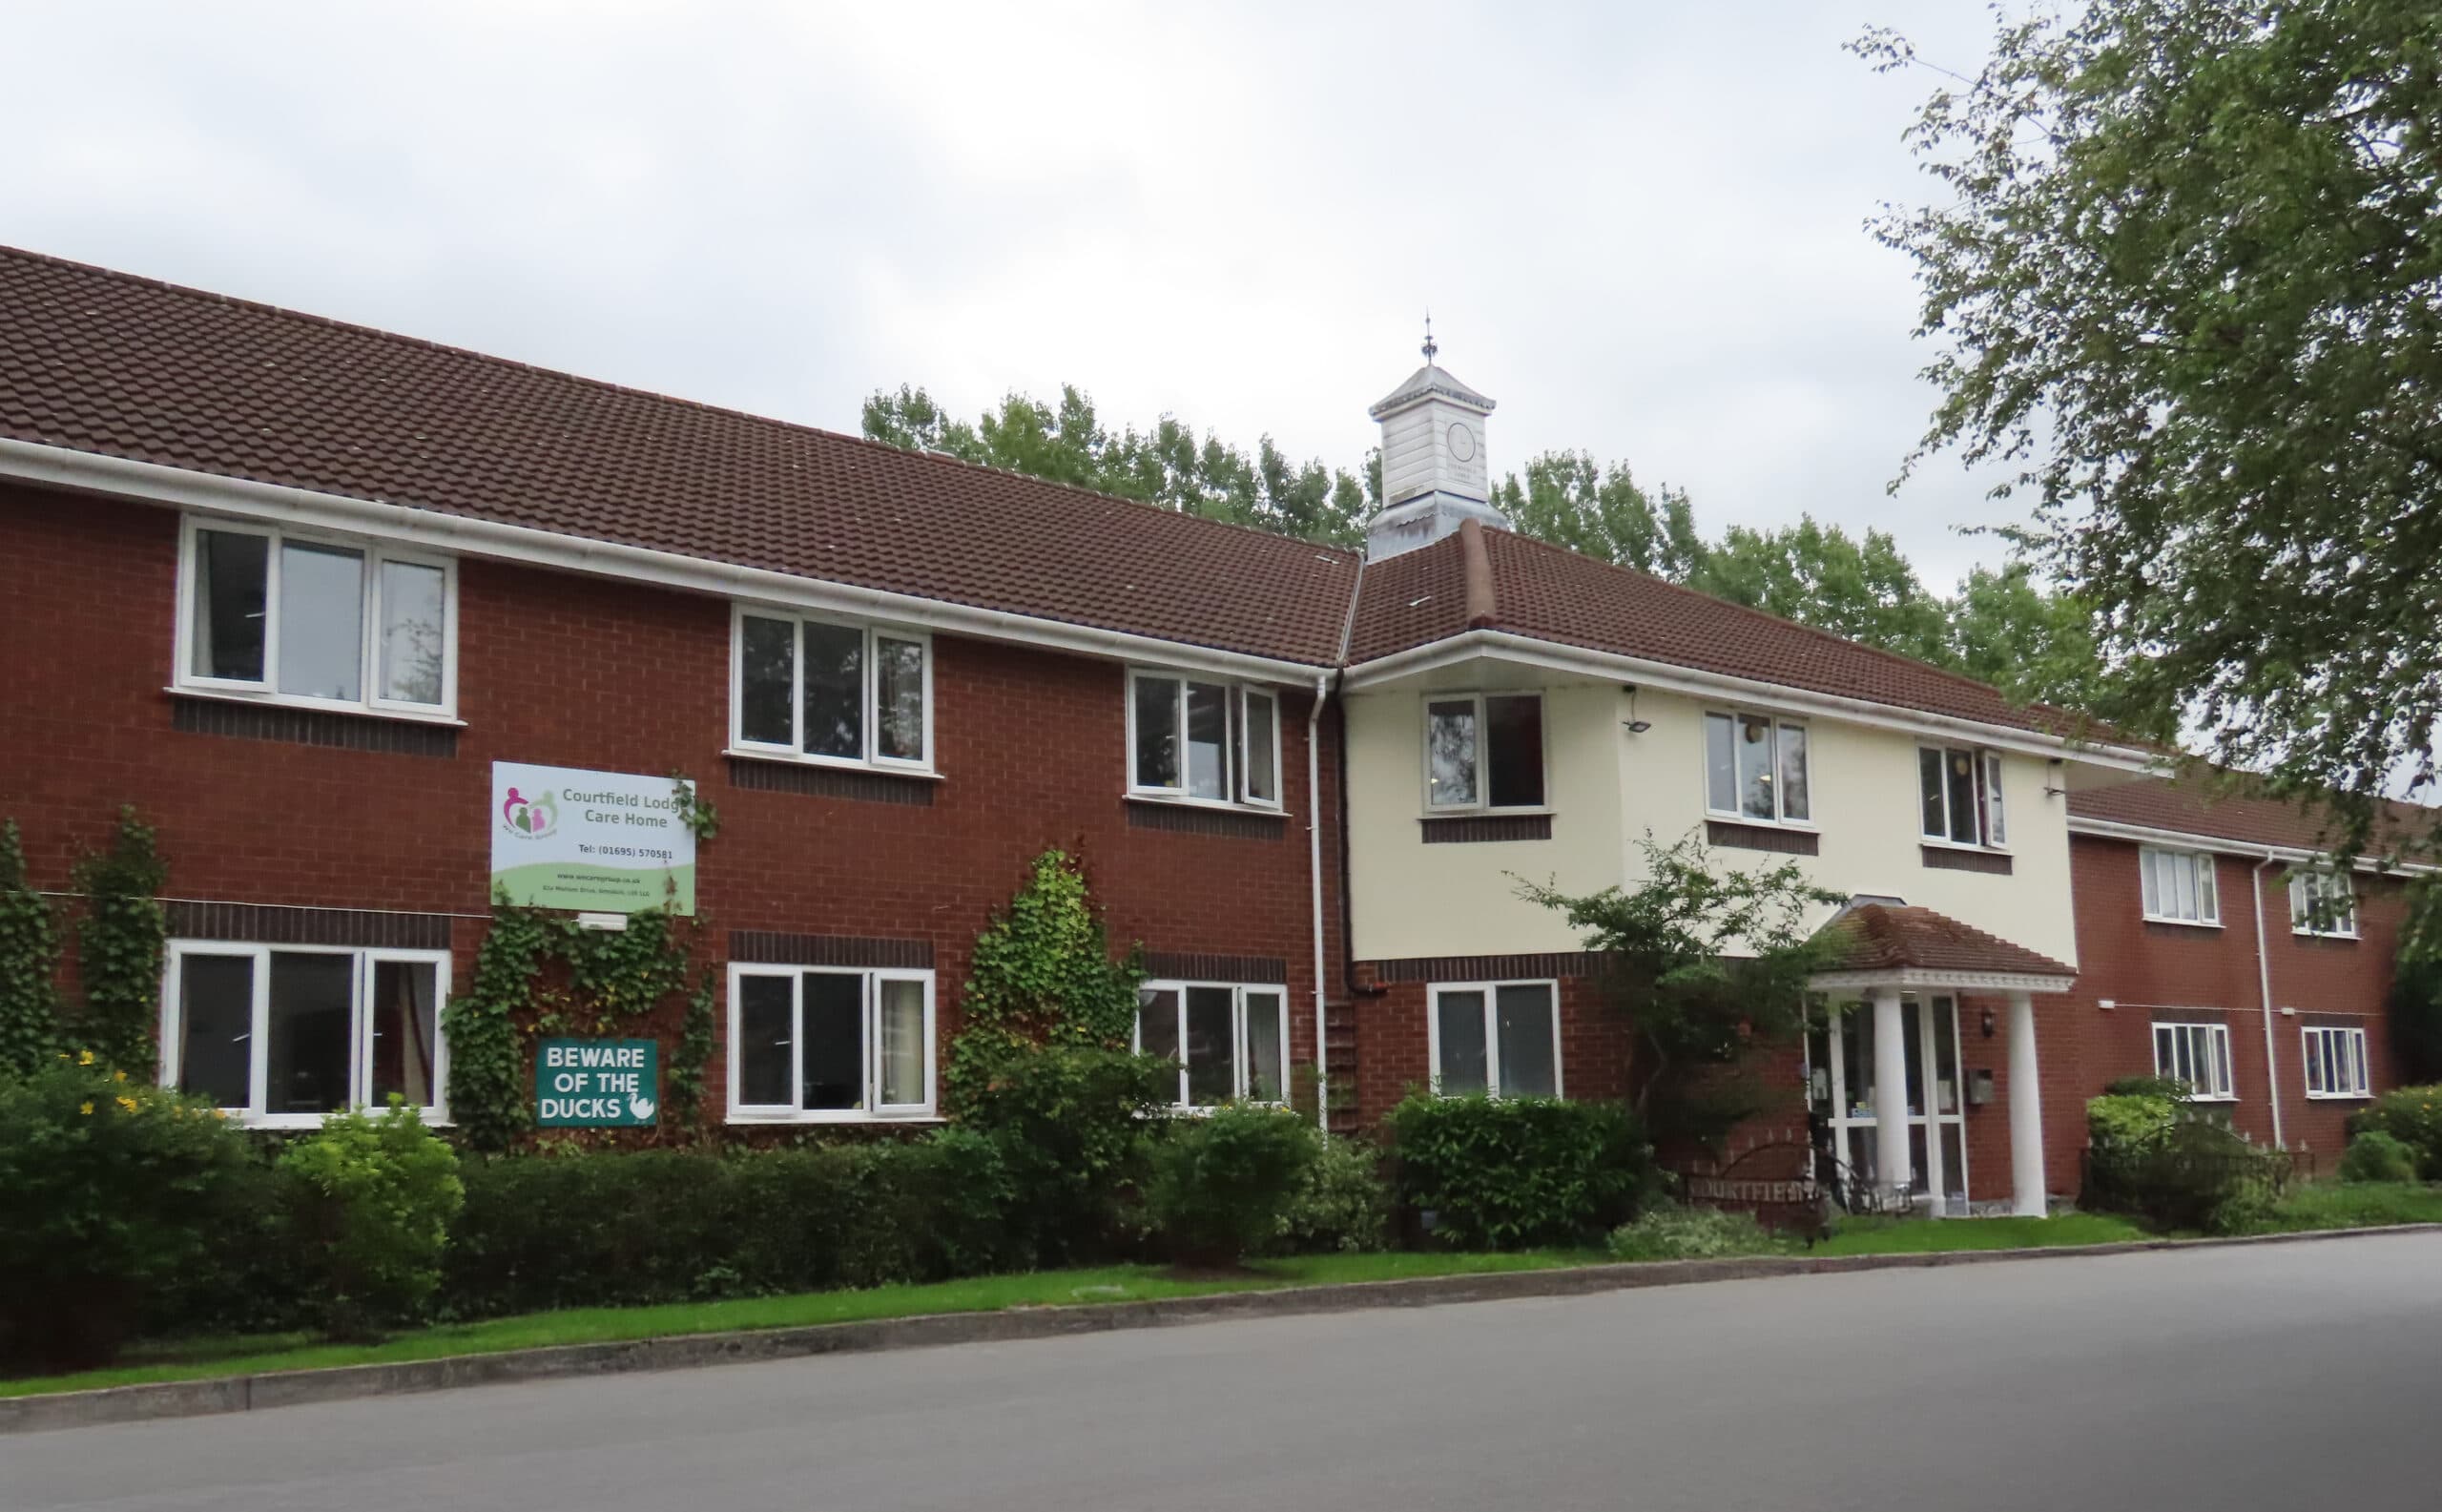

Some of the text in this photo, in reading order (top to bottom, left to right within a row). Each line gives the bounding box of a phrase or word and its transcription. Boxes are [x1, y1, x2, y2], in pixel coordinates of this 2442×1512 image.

[563, 788, 680, 814] Courtfield Lodg
[585, 809, 668, 828] Care Home
[579, 844, 673, 860] Tel: (01695) 570581
[547, 1047, 645, 1067] BEWARE
[553, 1072, 639, 1093] OF THE
[541, 1098, 621, 1119] DUCKS
[1689, 1180, 1805, 1202] OURTFIE
